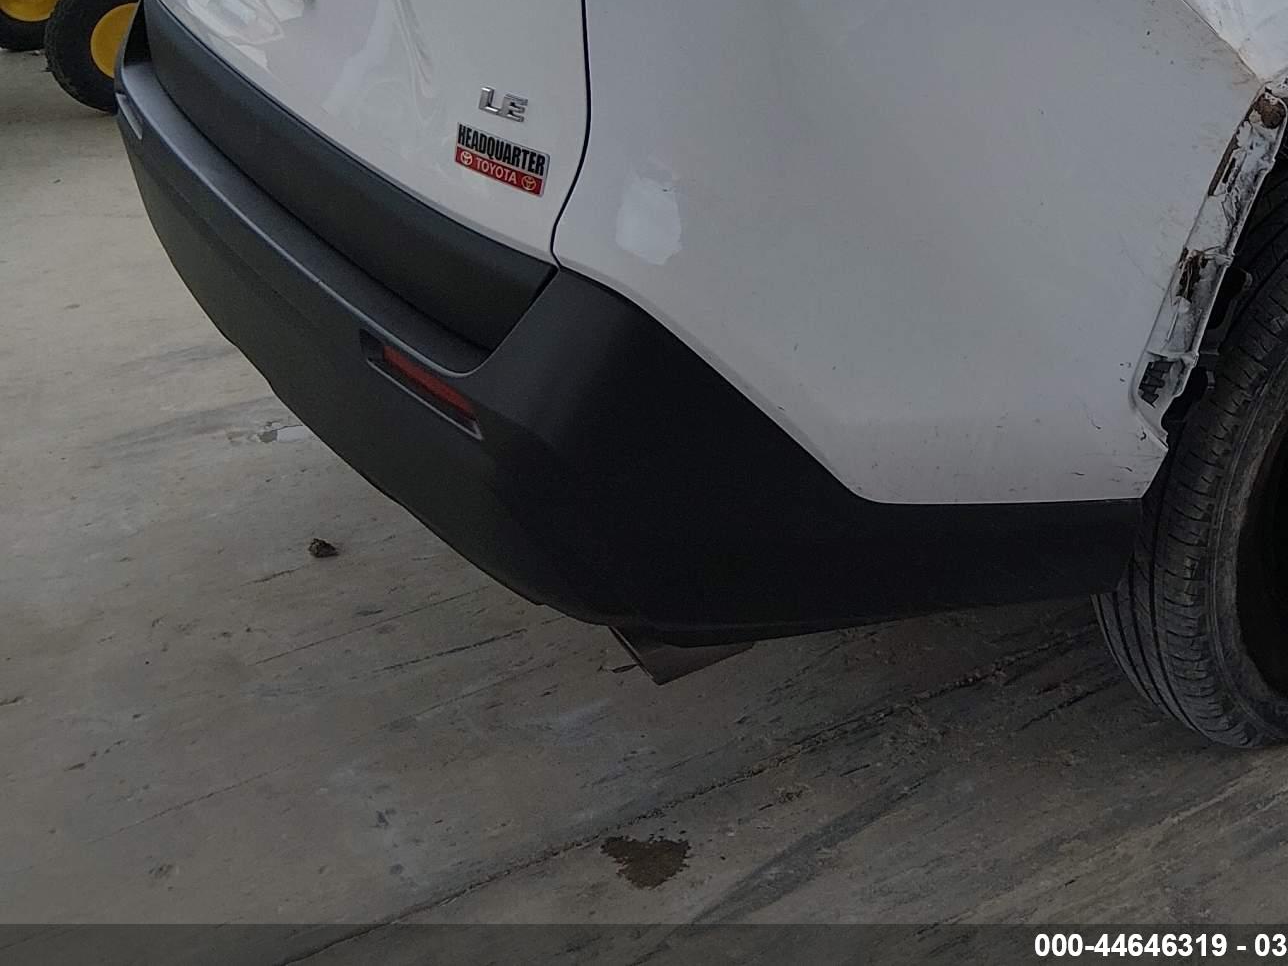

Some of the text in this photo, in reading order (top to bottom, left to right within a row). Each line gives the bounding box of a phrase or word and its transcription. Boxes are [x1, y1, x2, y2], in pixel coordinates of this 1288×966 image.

[478, 86, 528, 123] LE
[457, 123, 546, 176] HEADQUARTER
[475, 156, 518, 185] TOYOTA
